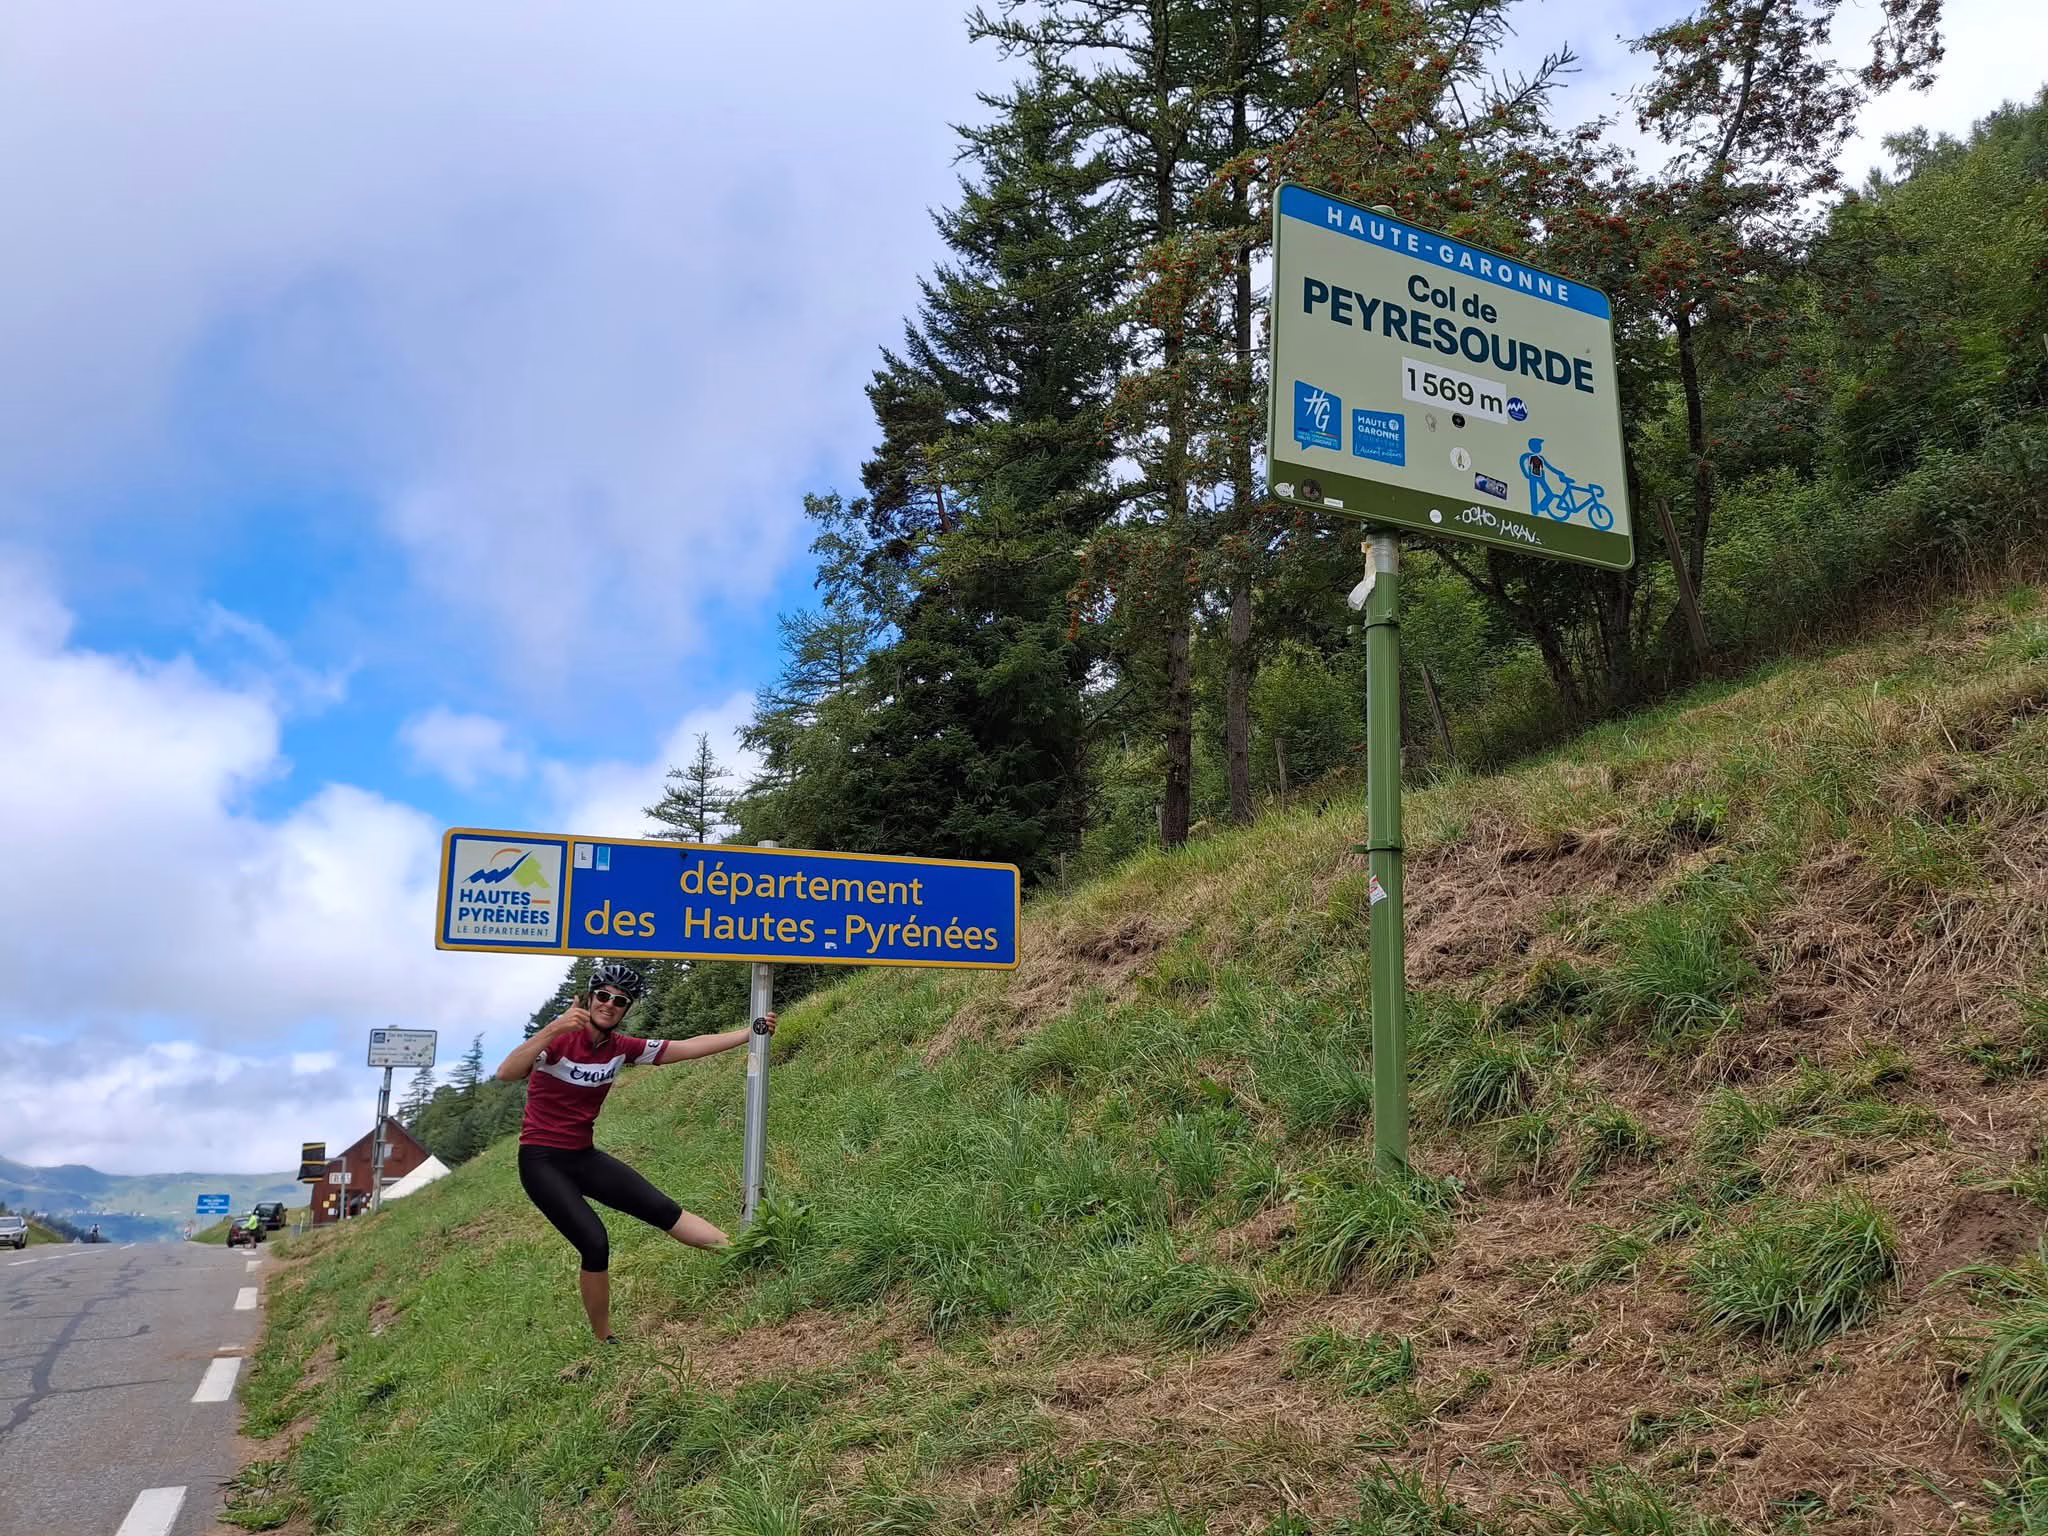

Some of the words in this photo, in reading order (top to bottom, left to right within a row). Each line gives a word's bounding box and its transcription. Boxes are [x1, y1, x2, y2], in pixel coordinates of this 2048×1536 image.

[1327, 206, 1569, 302] HAUTE-GARONNE
[1407, 274, 1455, 312] Col
[1462, 293, 1497, 323] de
[1303, 276, 1595, 394] PEYRESOURDE
[1480, 393, 1503, 414] m
[1357, 415, 1387, 430] HAUTE
[1357, 424, 1400, 441] GARONNE
[460, 888, 531, 906] HAUTES
[680, 862, 924, 905] département
[456, 926, 470, 934] LE
[474, 925, 550, 937] DÉPARTEMENT
[584, 900, 656, 937] des
